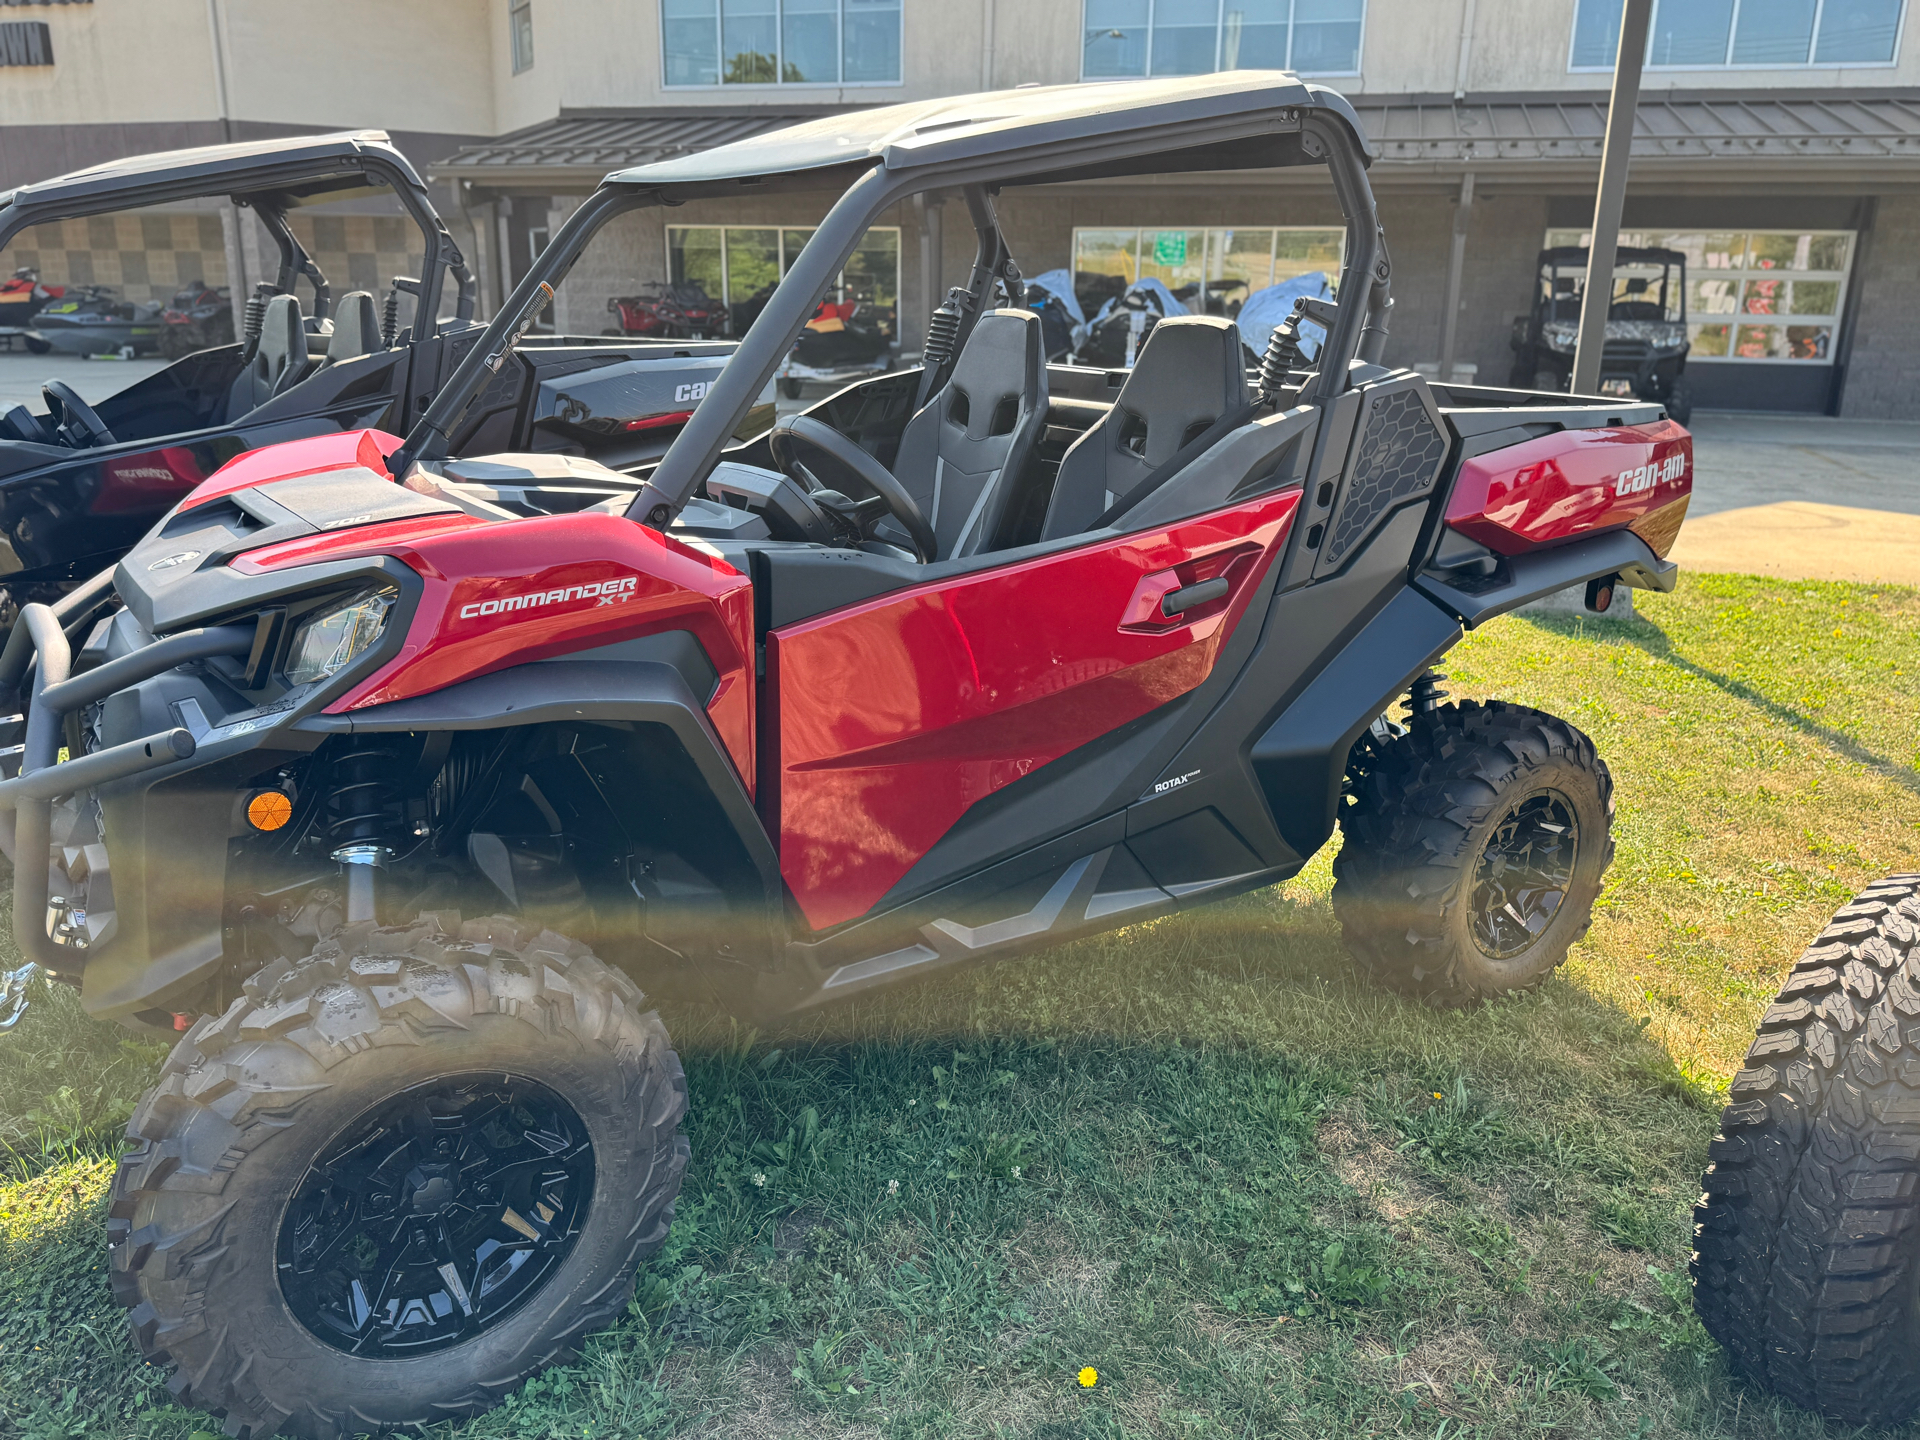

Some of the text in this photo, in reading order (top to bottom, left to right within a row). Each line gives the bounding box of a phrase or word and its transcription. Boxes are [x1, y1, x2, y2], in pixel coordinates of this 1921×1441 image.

[324, 515, 372, 529] 700
[460, 577, 637, 619] COMMANDER
[596, 591, 635, 607] XT
[1154, 774, 1188, 793] ROTAX
